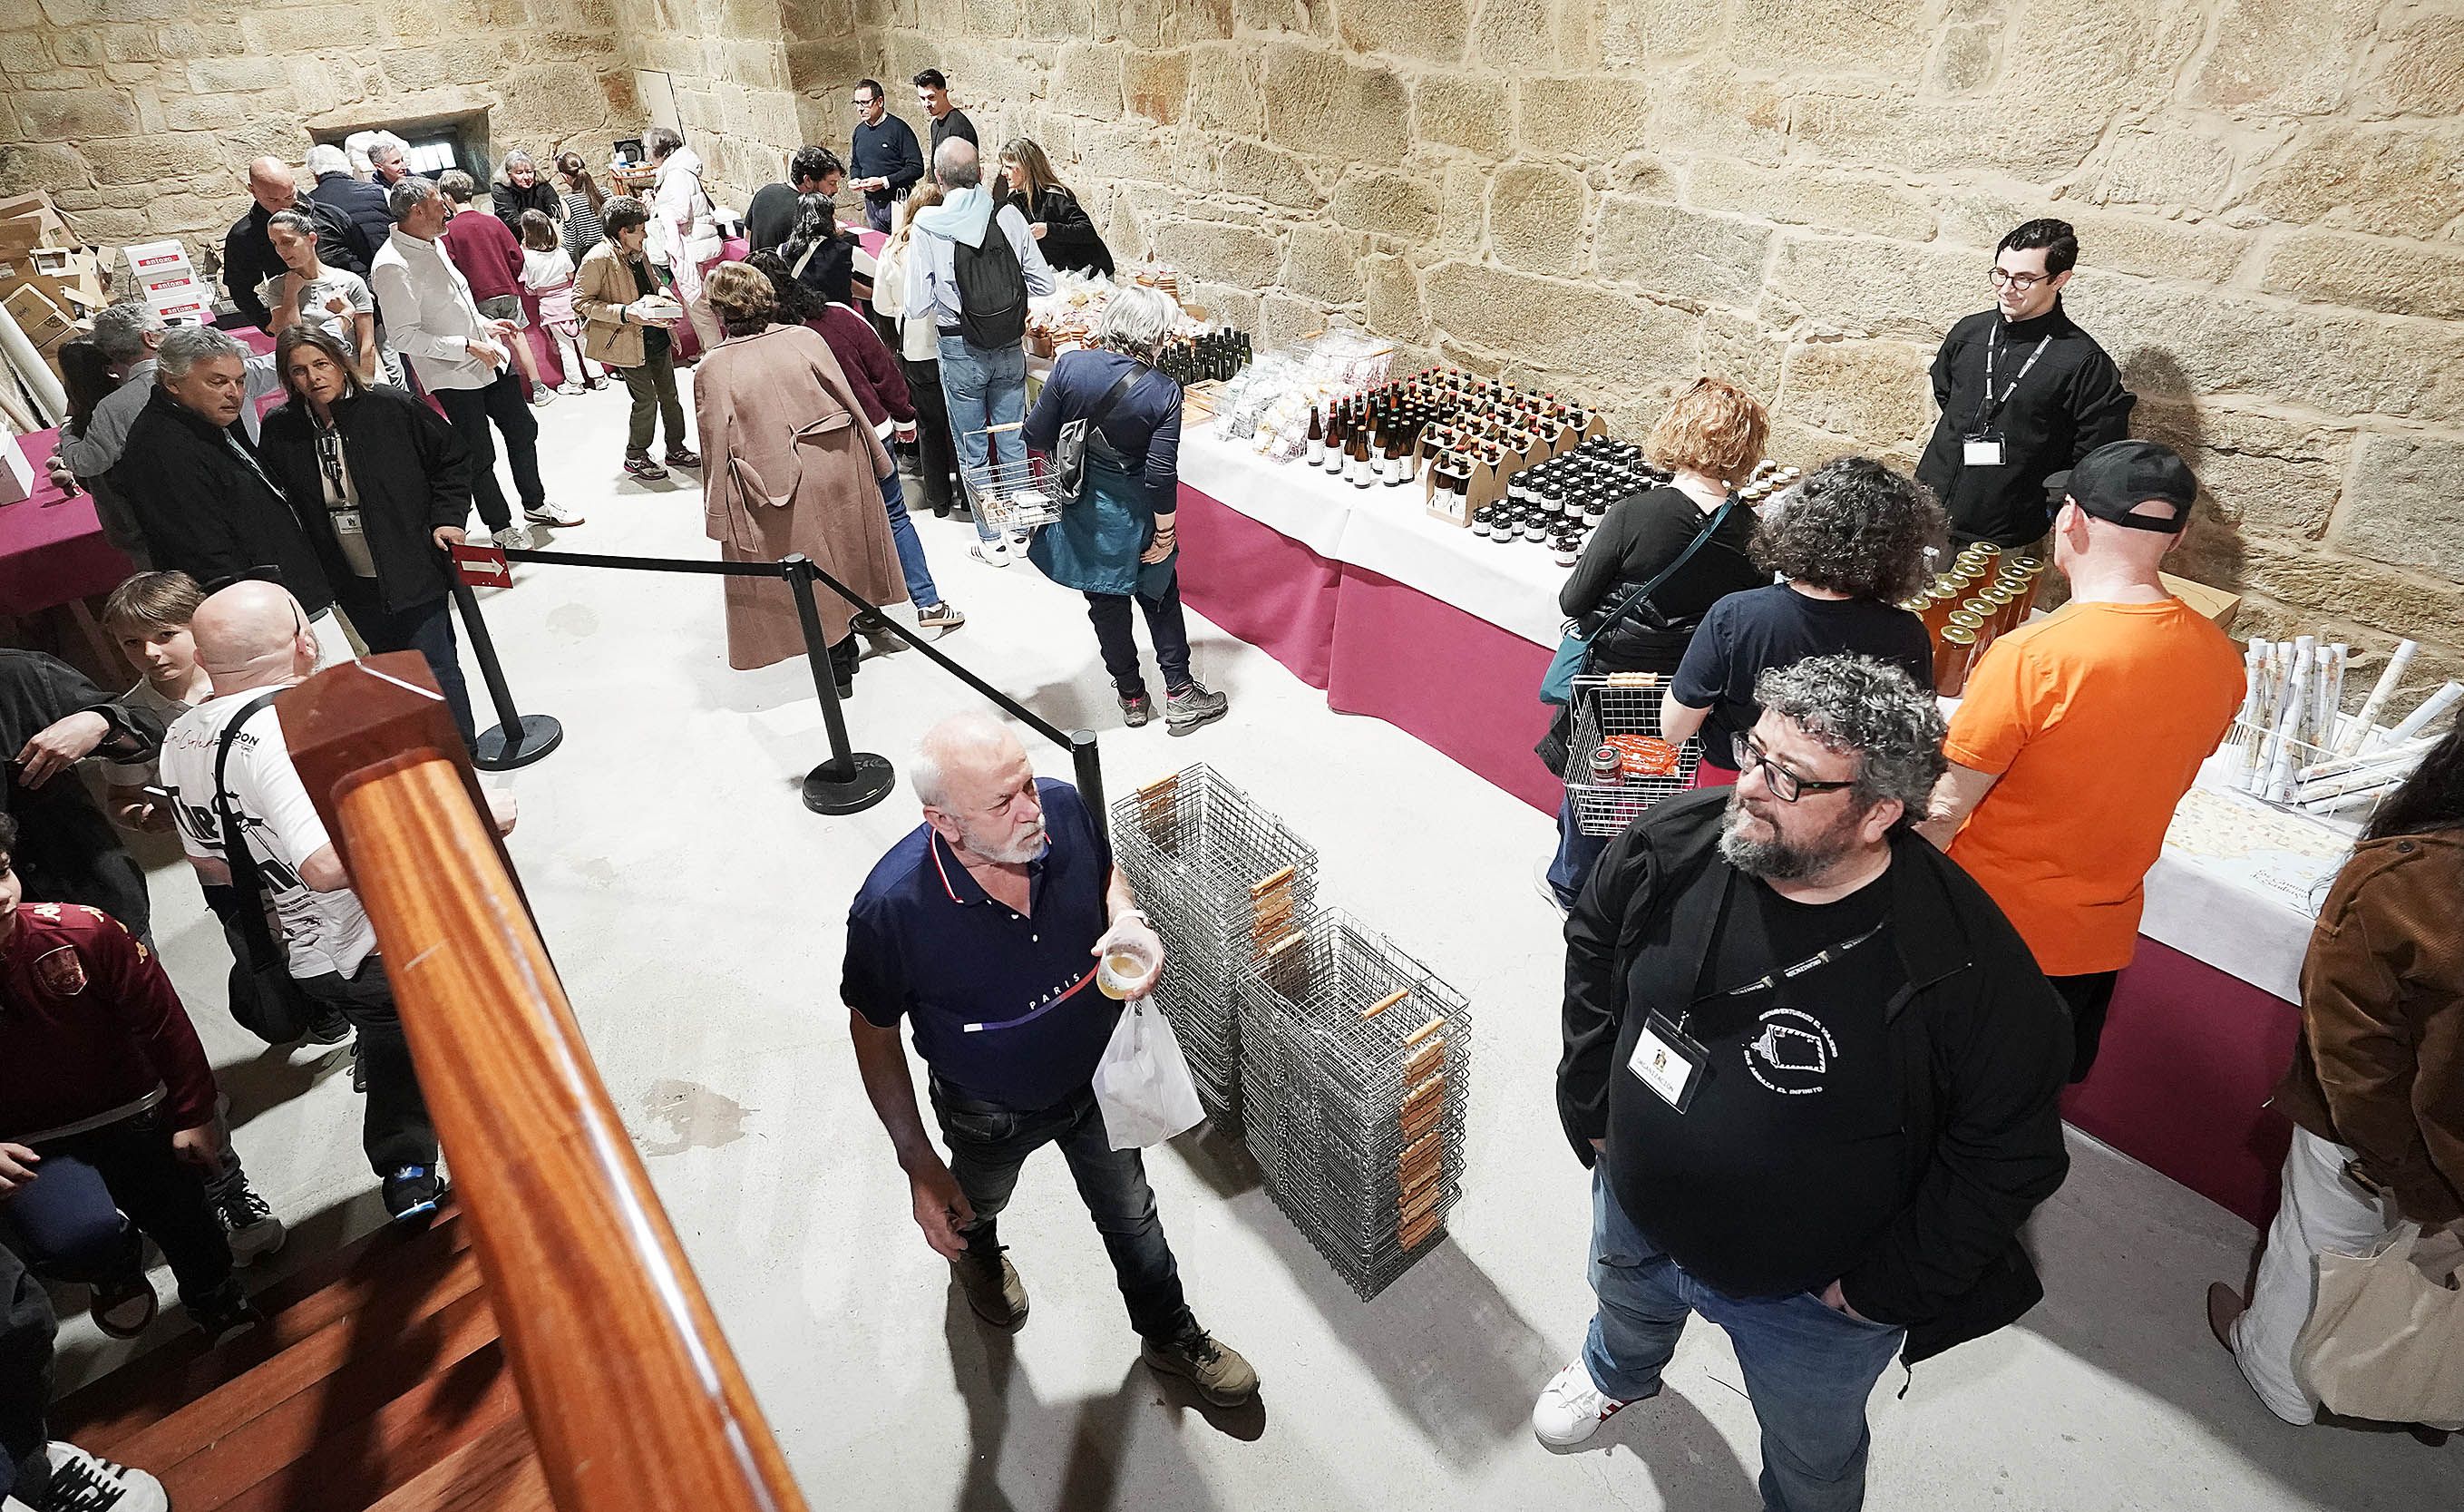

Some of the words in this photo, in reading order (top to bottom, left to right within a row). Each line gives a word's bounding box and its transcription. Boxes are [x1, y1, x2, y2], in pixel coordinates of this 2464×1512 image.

[1028, 972, 1080, 1010] PARIS
[1744, 1049, 1753, 1066] QUE
[1789, 1086, 1823, 1095] INFINITO
